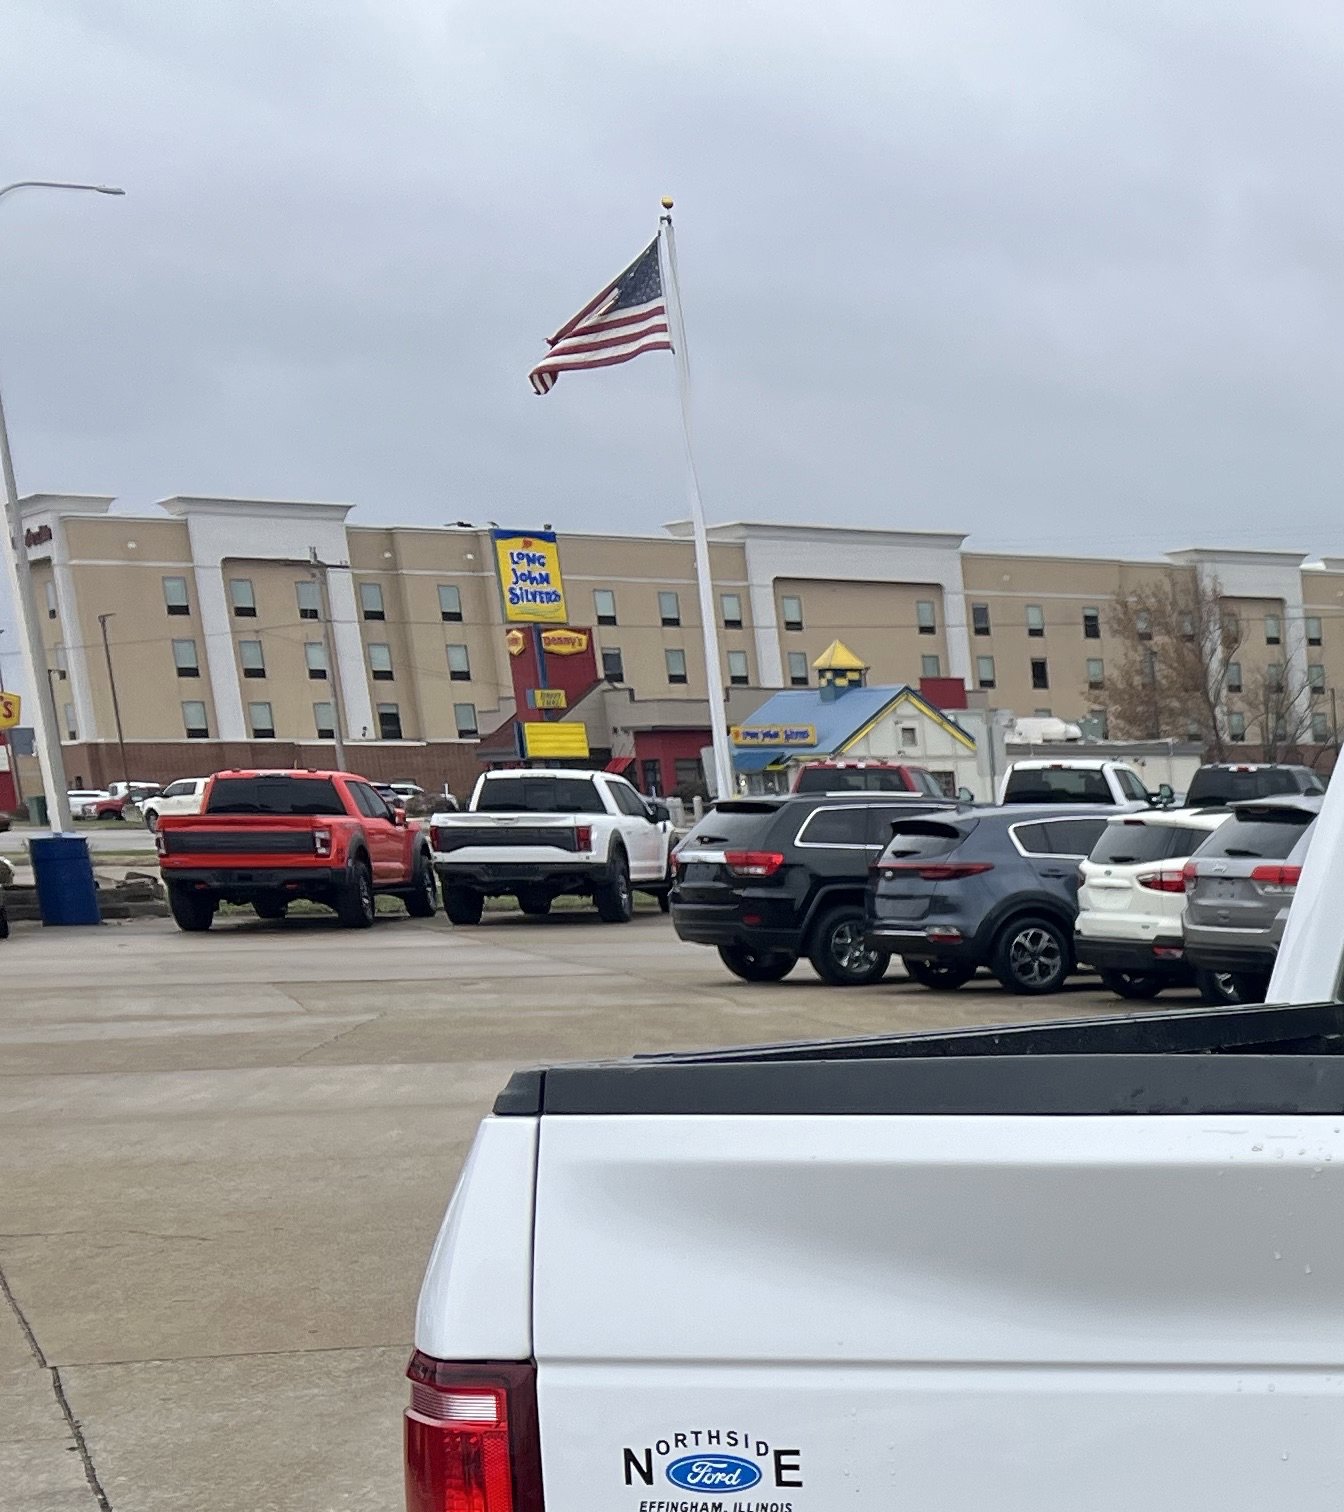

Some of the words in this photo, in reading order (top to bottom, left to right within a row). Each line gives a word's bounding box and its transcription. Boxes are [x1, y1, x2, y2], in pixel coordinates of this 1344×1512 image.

[509, 551, 546, 568] LONG
[623, 1429, 803, 1487] NORTHSIDE
[687, 1461, 742, 1485] Ford
